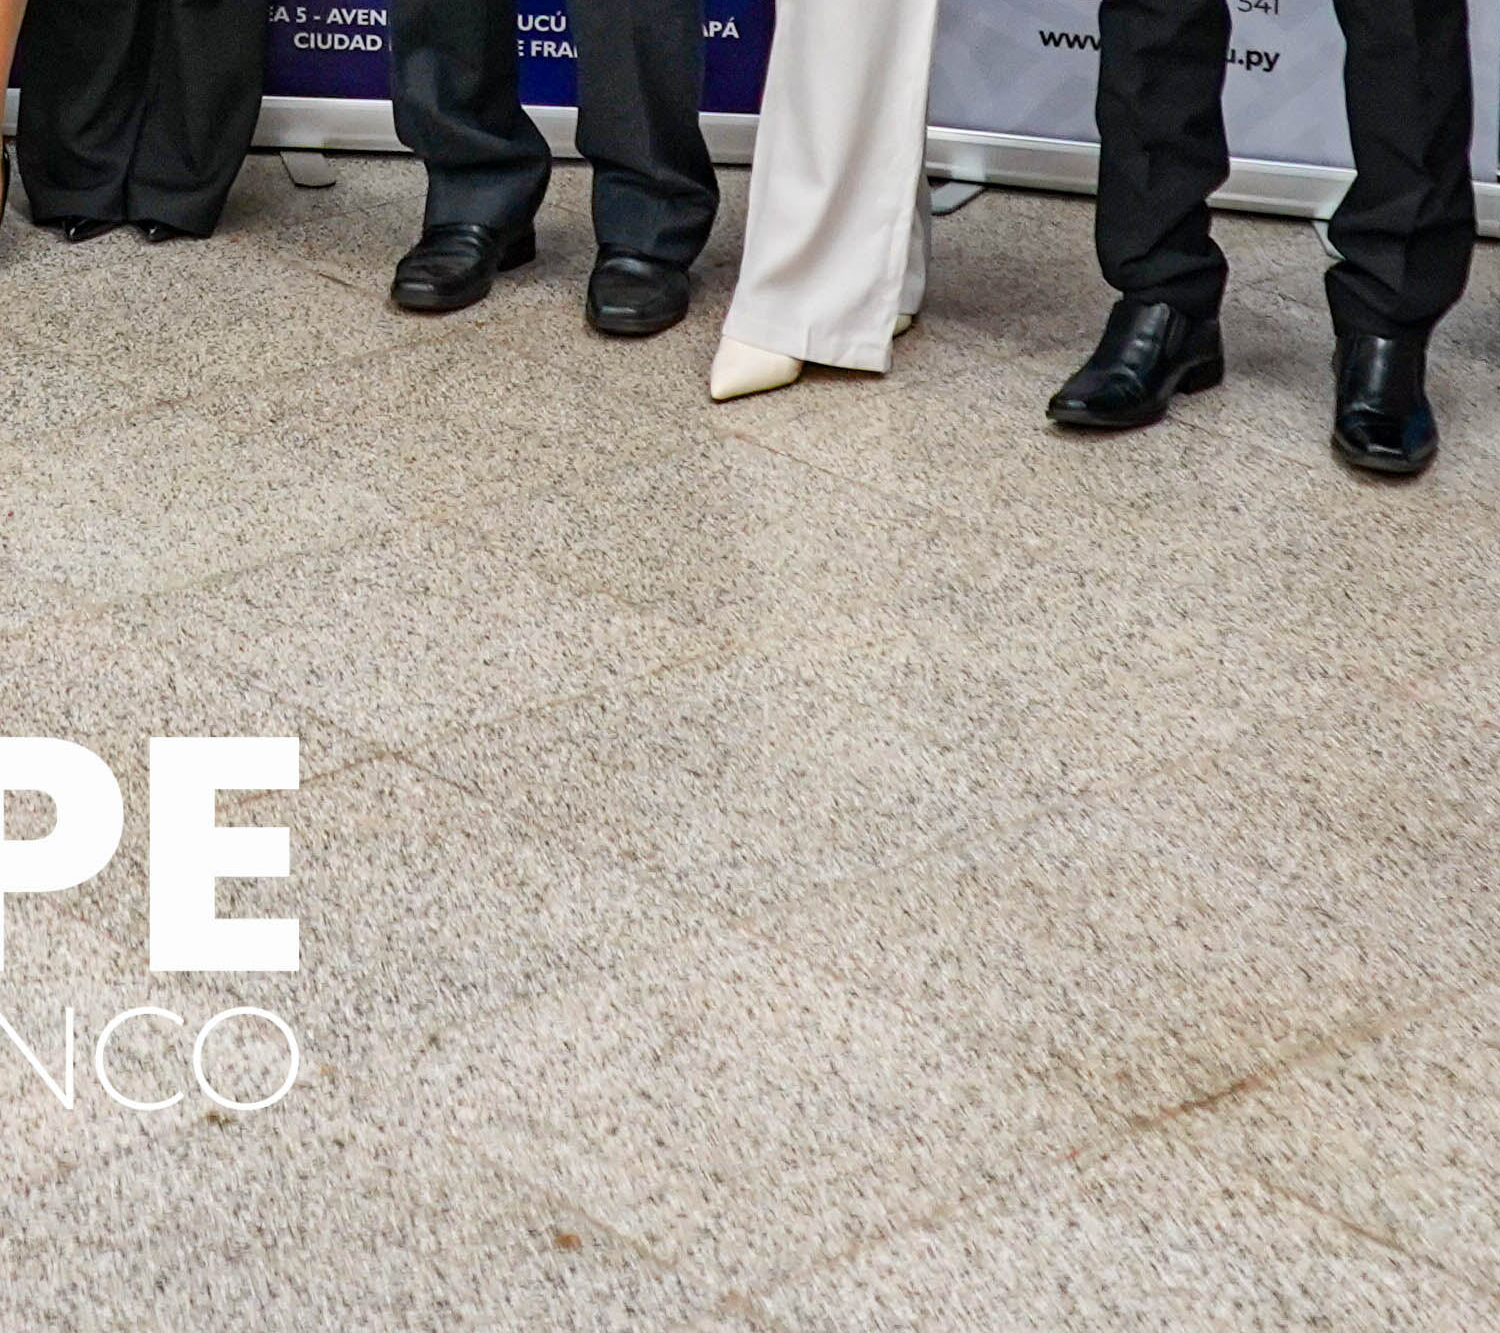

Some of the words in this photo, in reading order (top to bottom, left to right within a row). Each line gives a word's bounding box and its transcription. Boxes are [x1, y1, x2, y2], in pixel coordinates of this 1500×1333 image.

[296, 6, 307, 24] 5
[326, 8, 387, 27] AVEN
[293, 32, 382, 52] CIUDAD
